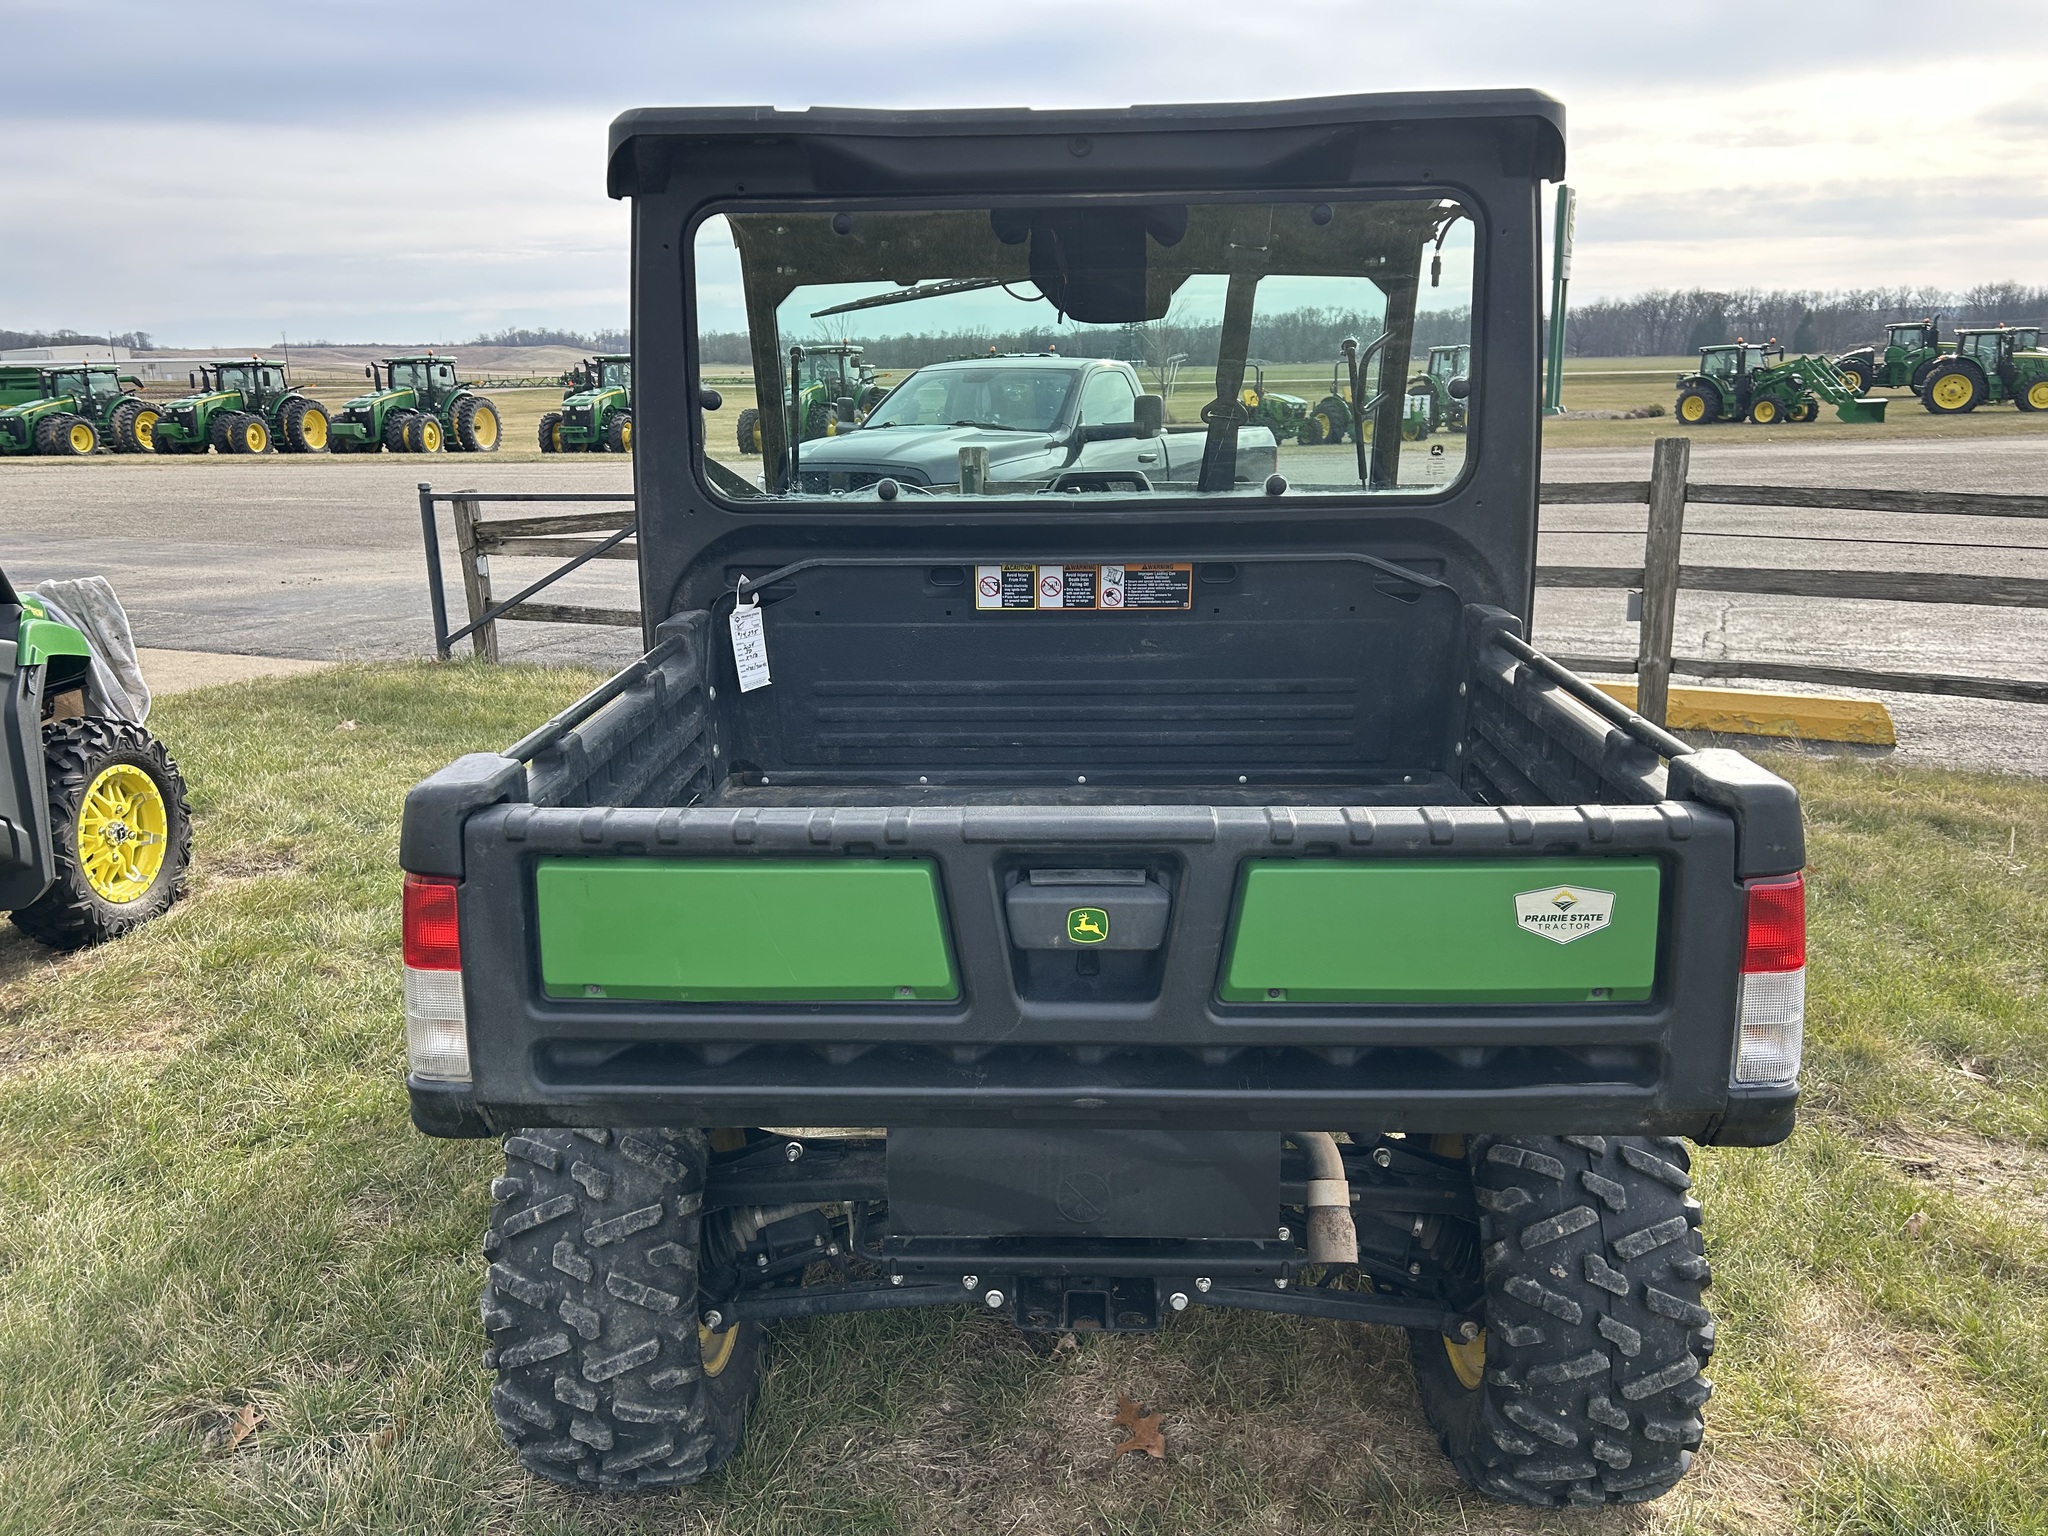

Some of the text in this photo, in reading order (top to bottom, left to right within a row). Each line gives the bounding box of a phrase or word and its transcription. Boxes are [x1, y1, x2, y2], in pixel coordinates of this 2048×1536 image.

[1525, 913, 1603, 922] PRAIRIE STATE
[1538, 922, 1590, 930] TRACTOR
